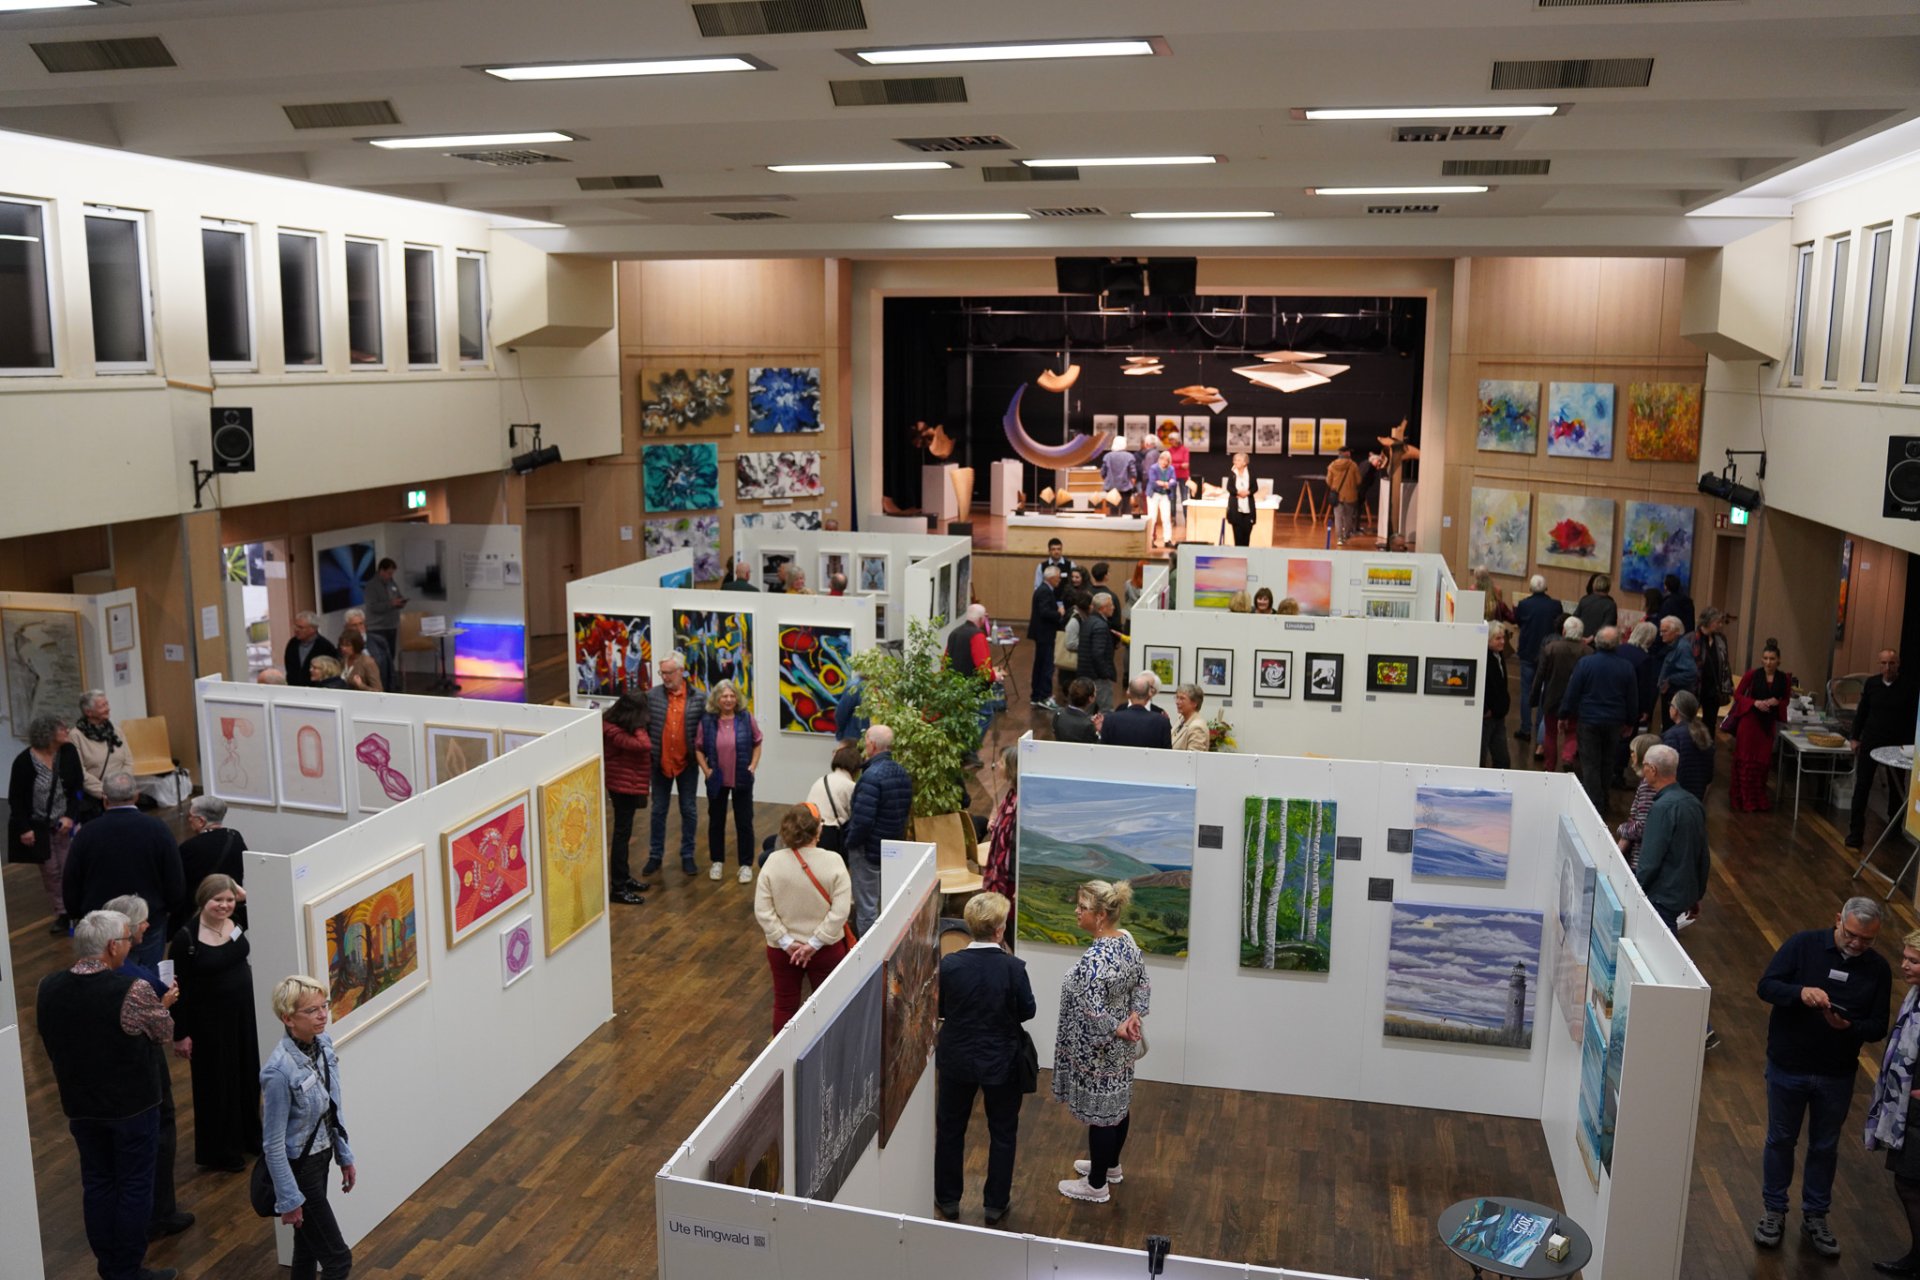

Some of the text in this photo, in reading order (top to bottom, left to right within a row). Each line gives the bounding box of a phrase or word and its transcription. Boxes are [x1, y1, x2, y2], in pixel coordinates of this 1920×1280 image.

[669, 1220, 749, 1245] Ute Ringwald
[1513, 1215, 1534, 1234] 2025
